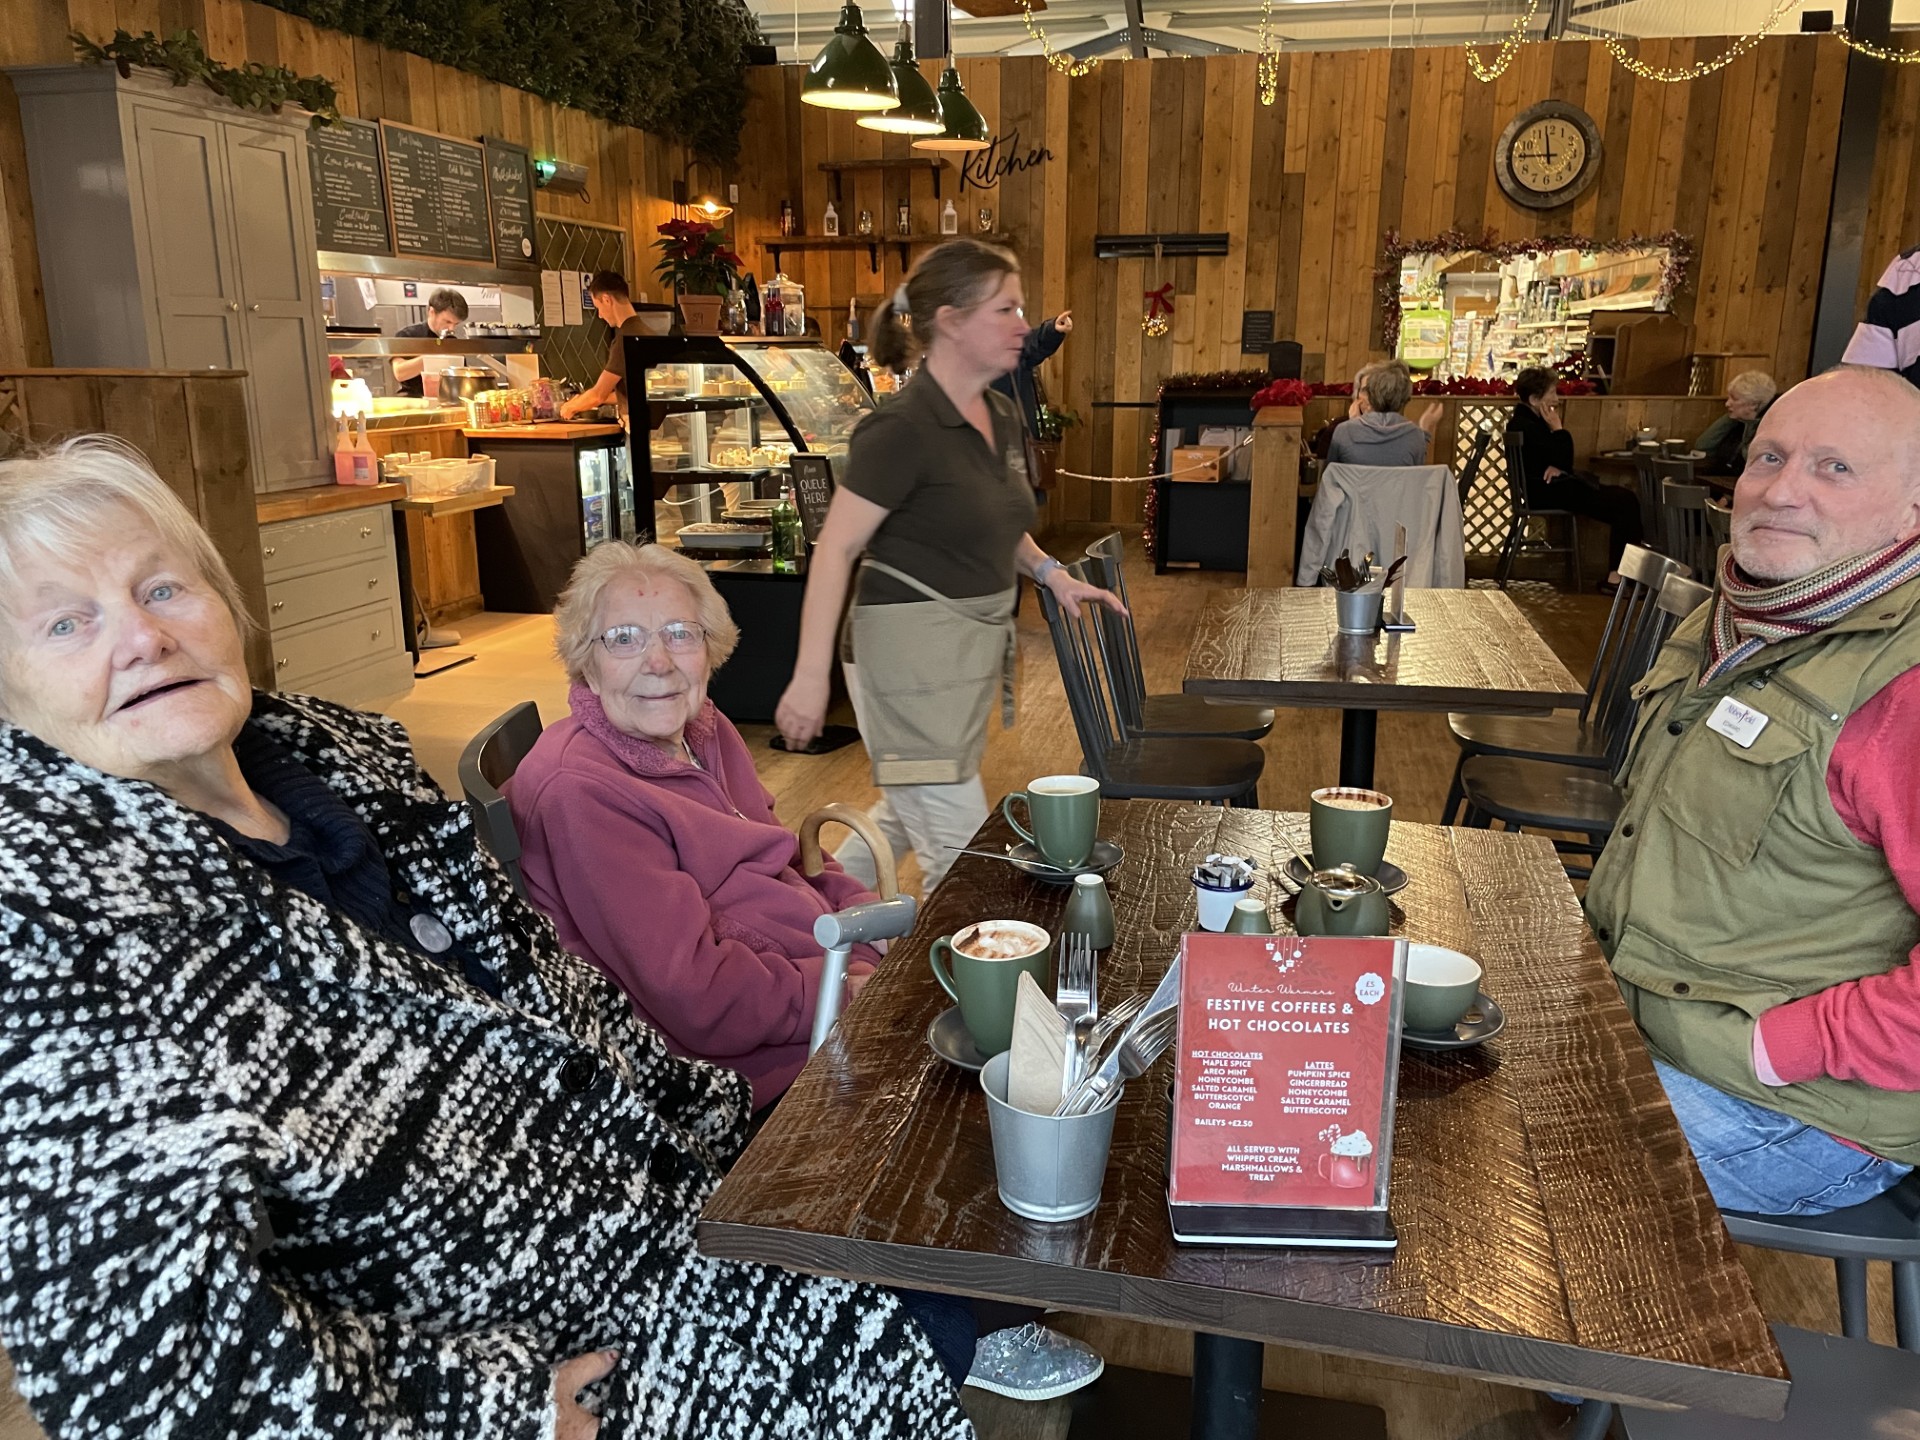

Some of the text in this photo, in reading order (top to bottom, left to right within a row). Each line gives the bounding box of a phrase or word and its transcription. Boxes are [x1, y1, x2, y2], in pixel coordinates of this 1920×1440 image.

[1561, 127, 1565, 138] 1
[1522, 140, 1533, 151] 10
[960, 128, 1055, 192] Kitchen
[1522, 164, 1529, 175] 8
[1532, 173, 1538, 183] 7
[1543, 175, 1550, 185] 6
[1555, 171, 1563, 182] 5
[800, 478, 827, 493] QUEUE
[803, 491, 828, 504] HERE
[1228, 982, 1336, 996] Winter Warmers
[1360, 988, 1379, 996] EACH
[1207, 999, 1354, 1014] FESTIVE COFFEES &
[1208, 1019, 1350, 1034] HOT CHOCOLATES
[1192, 1050, 1263, 1060] HOT CHOCOLATES
[1203, 1059, 1227, 1067] MAPLE
[1305, 1062, 1334, 1070] LATTES
[1228, 1068, 1247, 1076] MINT
[1288, 1070, 1326, 1078] PUMPKIN
[1198, 1076, 1254, 1085] HONEYCOMBE
[1290, 1079, 1347, 1088] GINGERBREAD
[1222, 1086, 1257, 1094] CARAMEL
[1288, 1088, 1347, 1096] HONEYCOMBE
[1194, 1094, 1254, 1102] BUTTERSCOTCH
[1281, 1097, 1351, 1106] SALTED CARAMEL
[1208, 1102, 1241, 1110] ORANGE
[1284, 1106, 1347, 1115] BUTTERSCOTCH
[1228, 1120, 1253, 1128] +£2.50
[1244, 1146, 1275, 1154] SERVED
[1277, 1146, 1300, 1154] WITH
[1227, 1154, 1299, 1164] WHIPPED CREAM,
[1222, 1163, 1302, 1173] MARSHMALLOWS &
